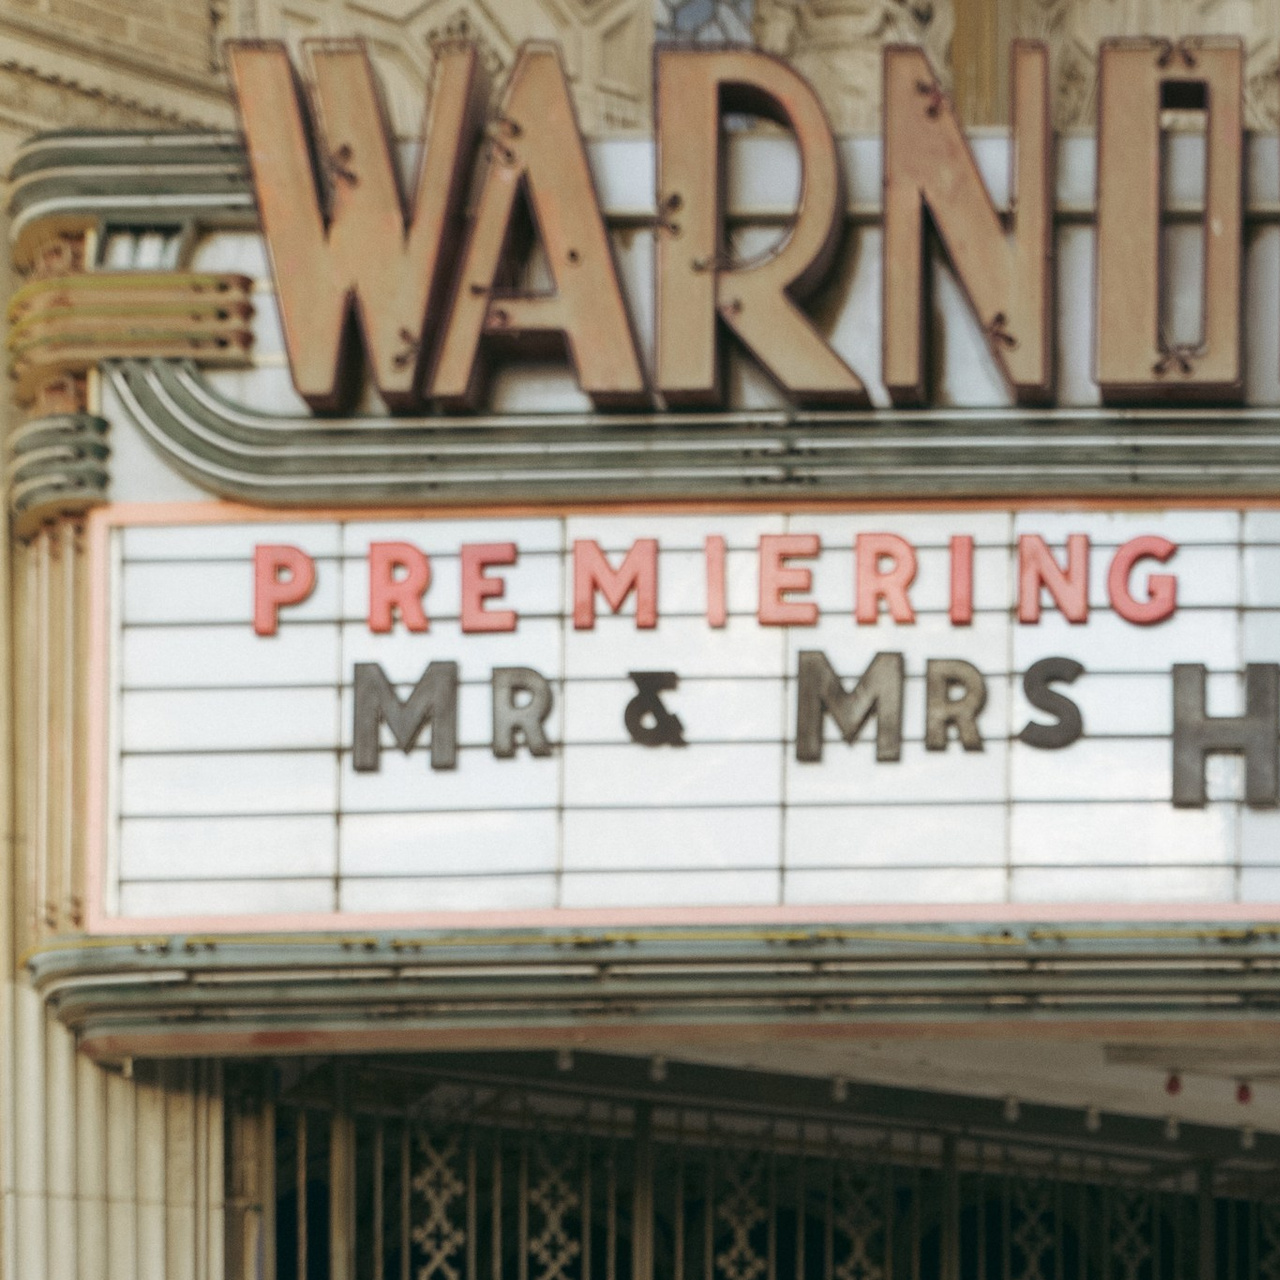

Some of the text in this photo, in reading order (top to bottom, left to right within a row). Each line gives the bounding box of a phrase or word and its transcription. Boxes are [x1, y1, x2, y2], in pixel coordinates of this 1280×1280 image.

[253, 532, 1178, 637] PREMIERING
[351, 659, 556, 771] MR
[624, 670, 687, 748] &
[796, 650, 1085, 764] MRS
